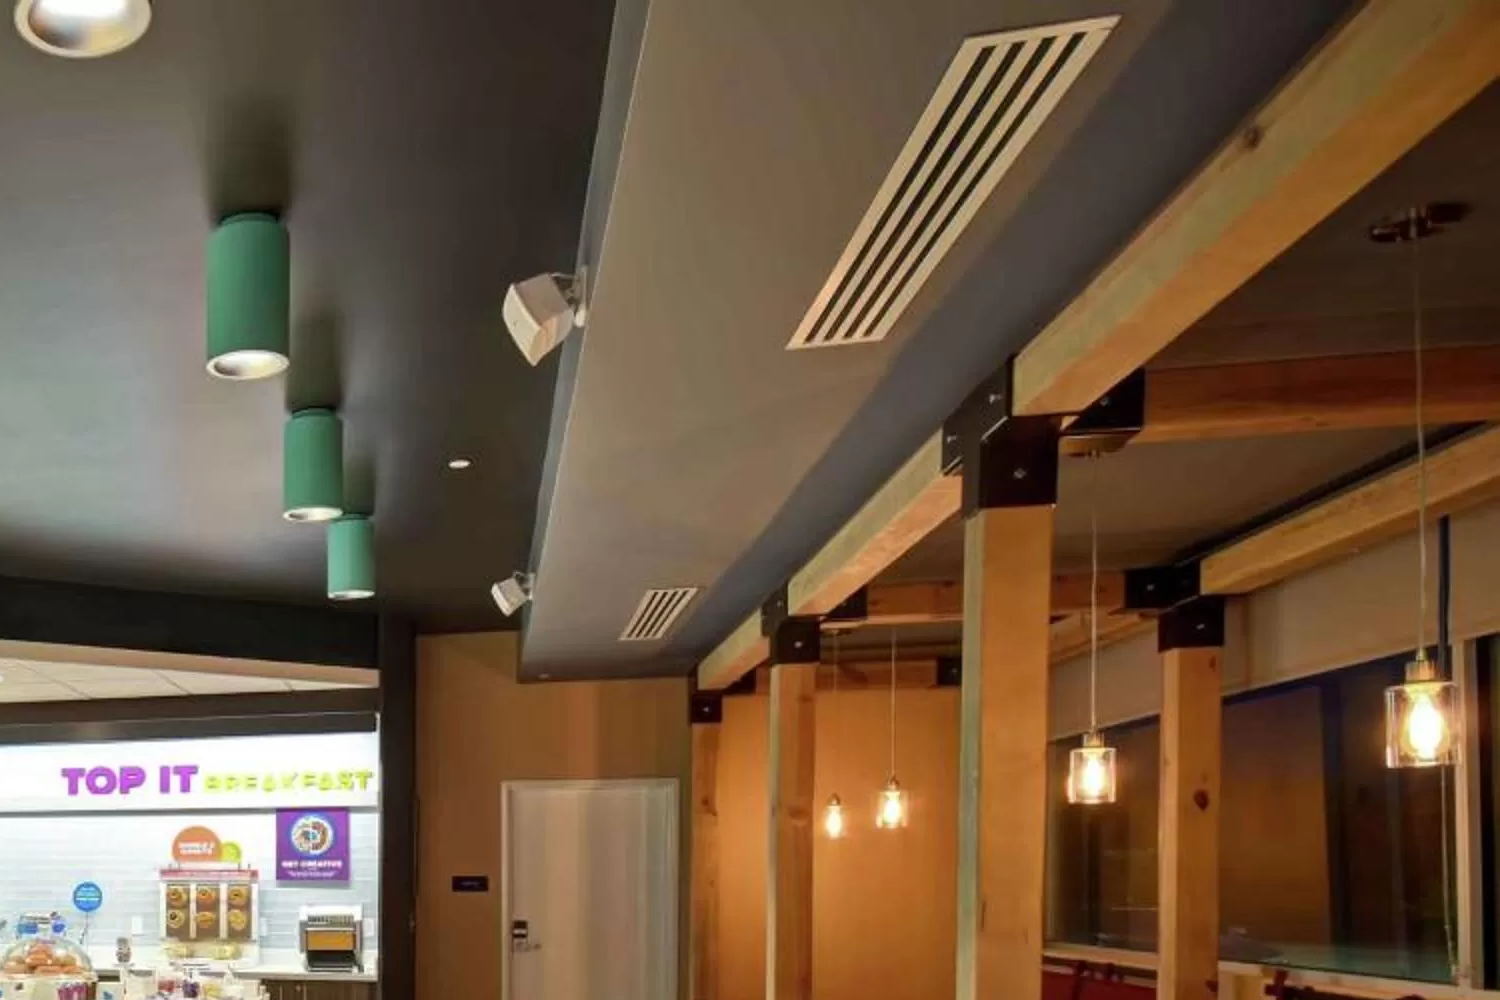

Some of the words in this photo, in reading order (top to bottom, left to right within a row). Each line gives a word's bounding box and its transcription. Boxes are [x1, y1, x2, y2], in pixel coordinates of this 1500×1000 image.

[60, 765, 147, 796] TOP
[159, 765, 199, 794] IT
[203, 769, 374, 793] BREAKFAST
